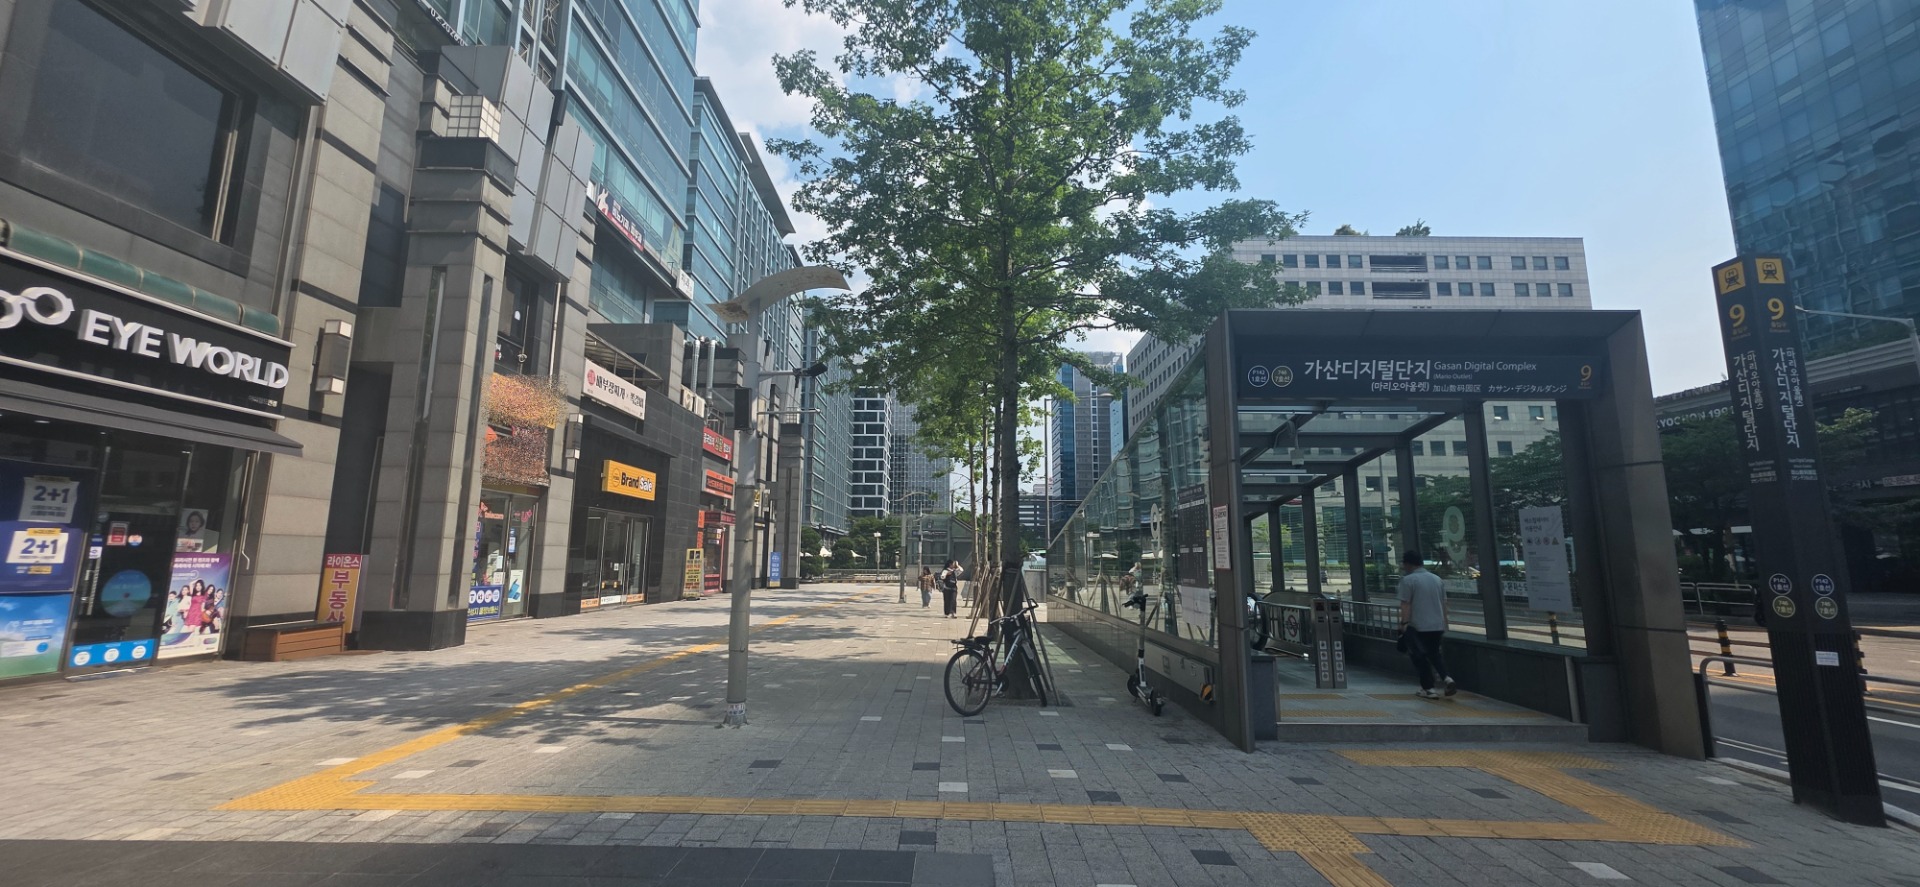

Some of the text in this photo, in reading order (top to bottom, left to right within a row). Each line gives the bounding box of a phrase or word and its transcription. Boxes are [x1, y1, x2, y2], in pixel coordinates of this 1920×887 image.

[1729, 304, 1745, 328] 9
[1767, 297, 1784, 320] 9
[78, 309, 289, 389] EYE WORLD
[1304, 359, 1431, 381] 가산디지털단지
[1433, 361, 1537, 373] Gasan Digital Complex
[1580, 364, 1592, 381] 9
[1371, 381, 1430, 393] (마리오아울렛)
[1772, 347, 1800, 448] 가산디지털단지
[1734, 353, 1760, 452] 가산디지털단지
[620, 471, 653, 492] Brand Sale
[33, 485, 71, 504] 2+1
[21, 538, 58, 555] 2+1
[327, 555, 359, 568] 라이온스
